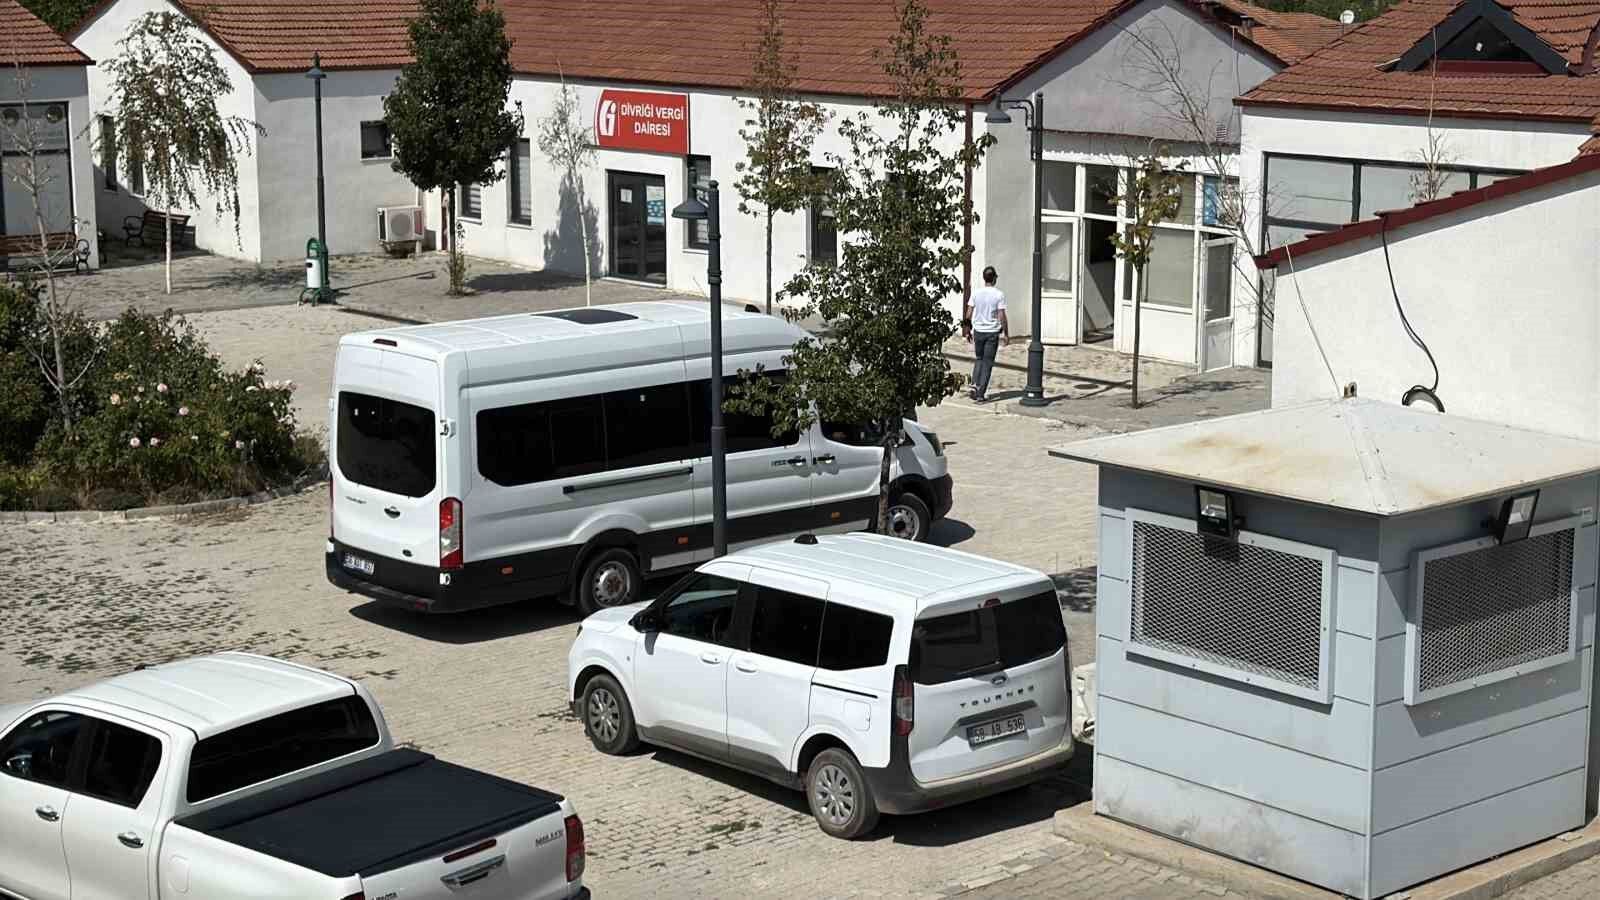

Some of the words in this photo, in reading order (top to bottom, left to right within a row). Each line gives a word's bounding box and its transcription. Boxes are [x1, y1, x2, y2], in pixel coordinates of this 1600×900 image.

[621, 102, 653, 118] DİVRİĞİ
[655, 106, 684, 120] VERGİ
[634, 121, 670, 136] DAİRESİ
